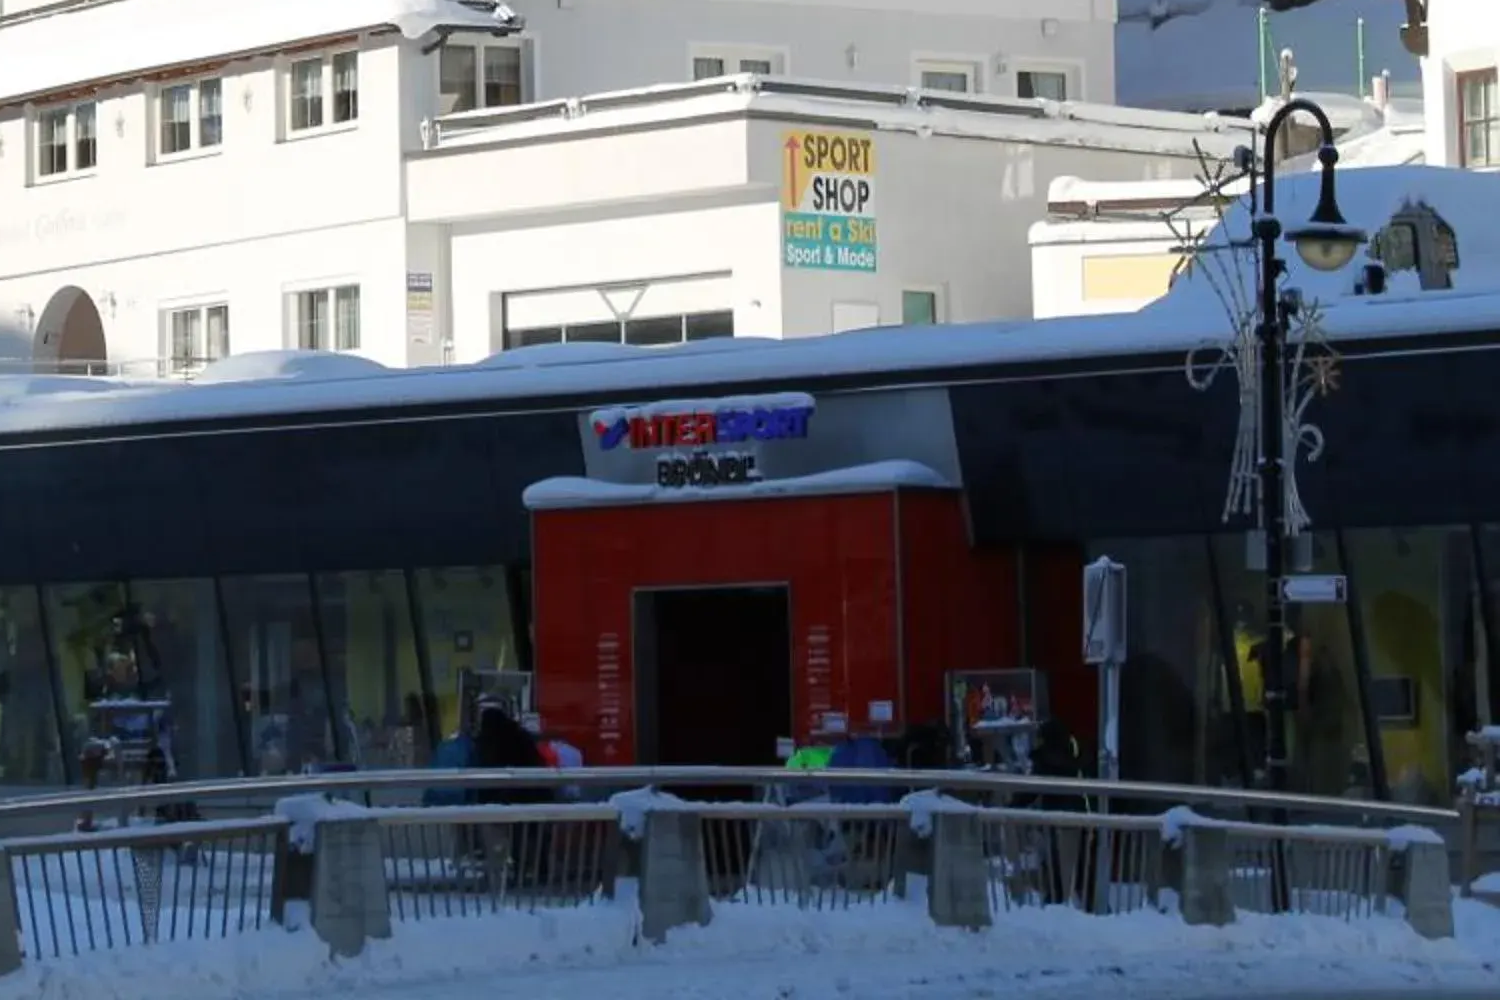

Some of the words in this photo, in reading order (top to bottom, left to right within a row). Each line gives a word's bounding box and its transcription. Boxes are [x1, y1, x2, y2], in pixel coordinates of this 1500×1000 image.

[803, 133, 872, 173] SPORT
[812, 176, 870, 213] SHOP
[787, 243, 821, 267] Sport
[837, 247, 875, 268] Mode
[627, 405, 814, 449] INTERSPORT
